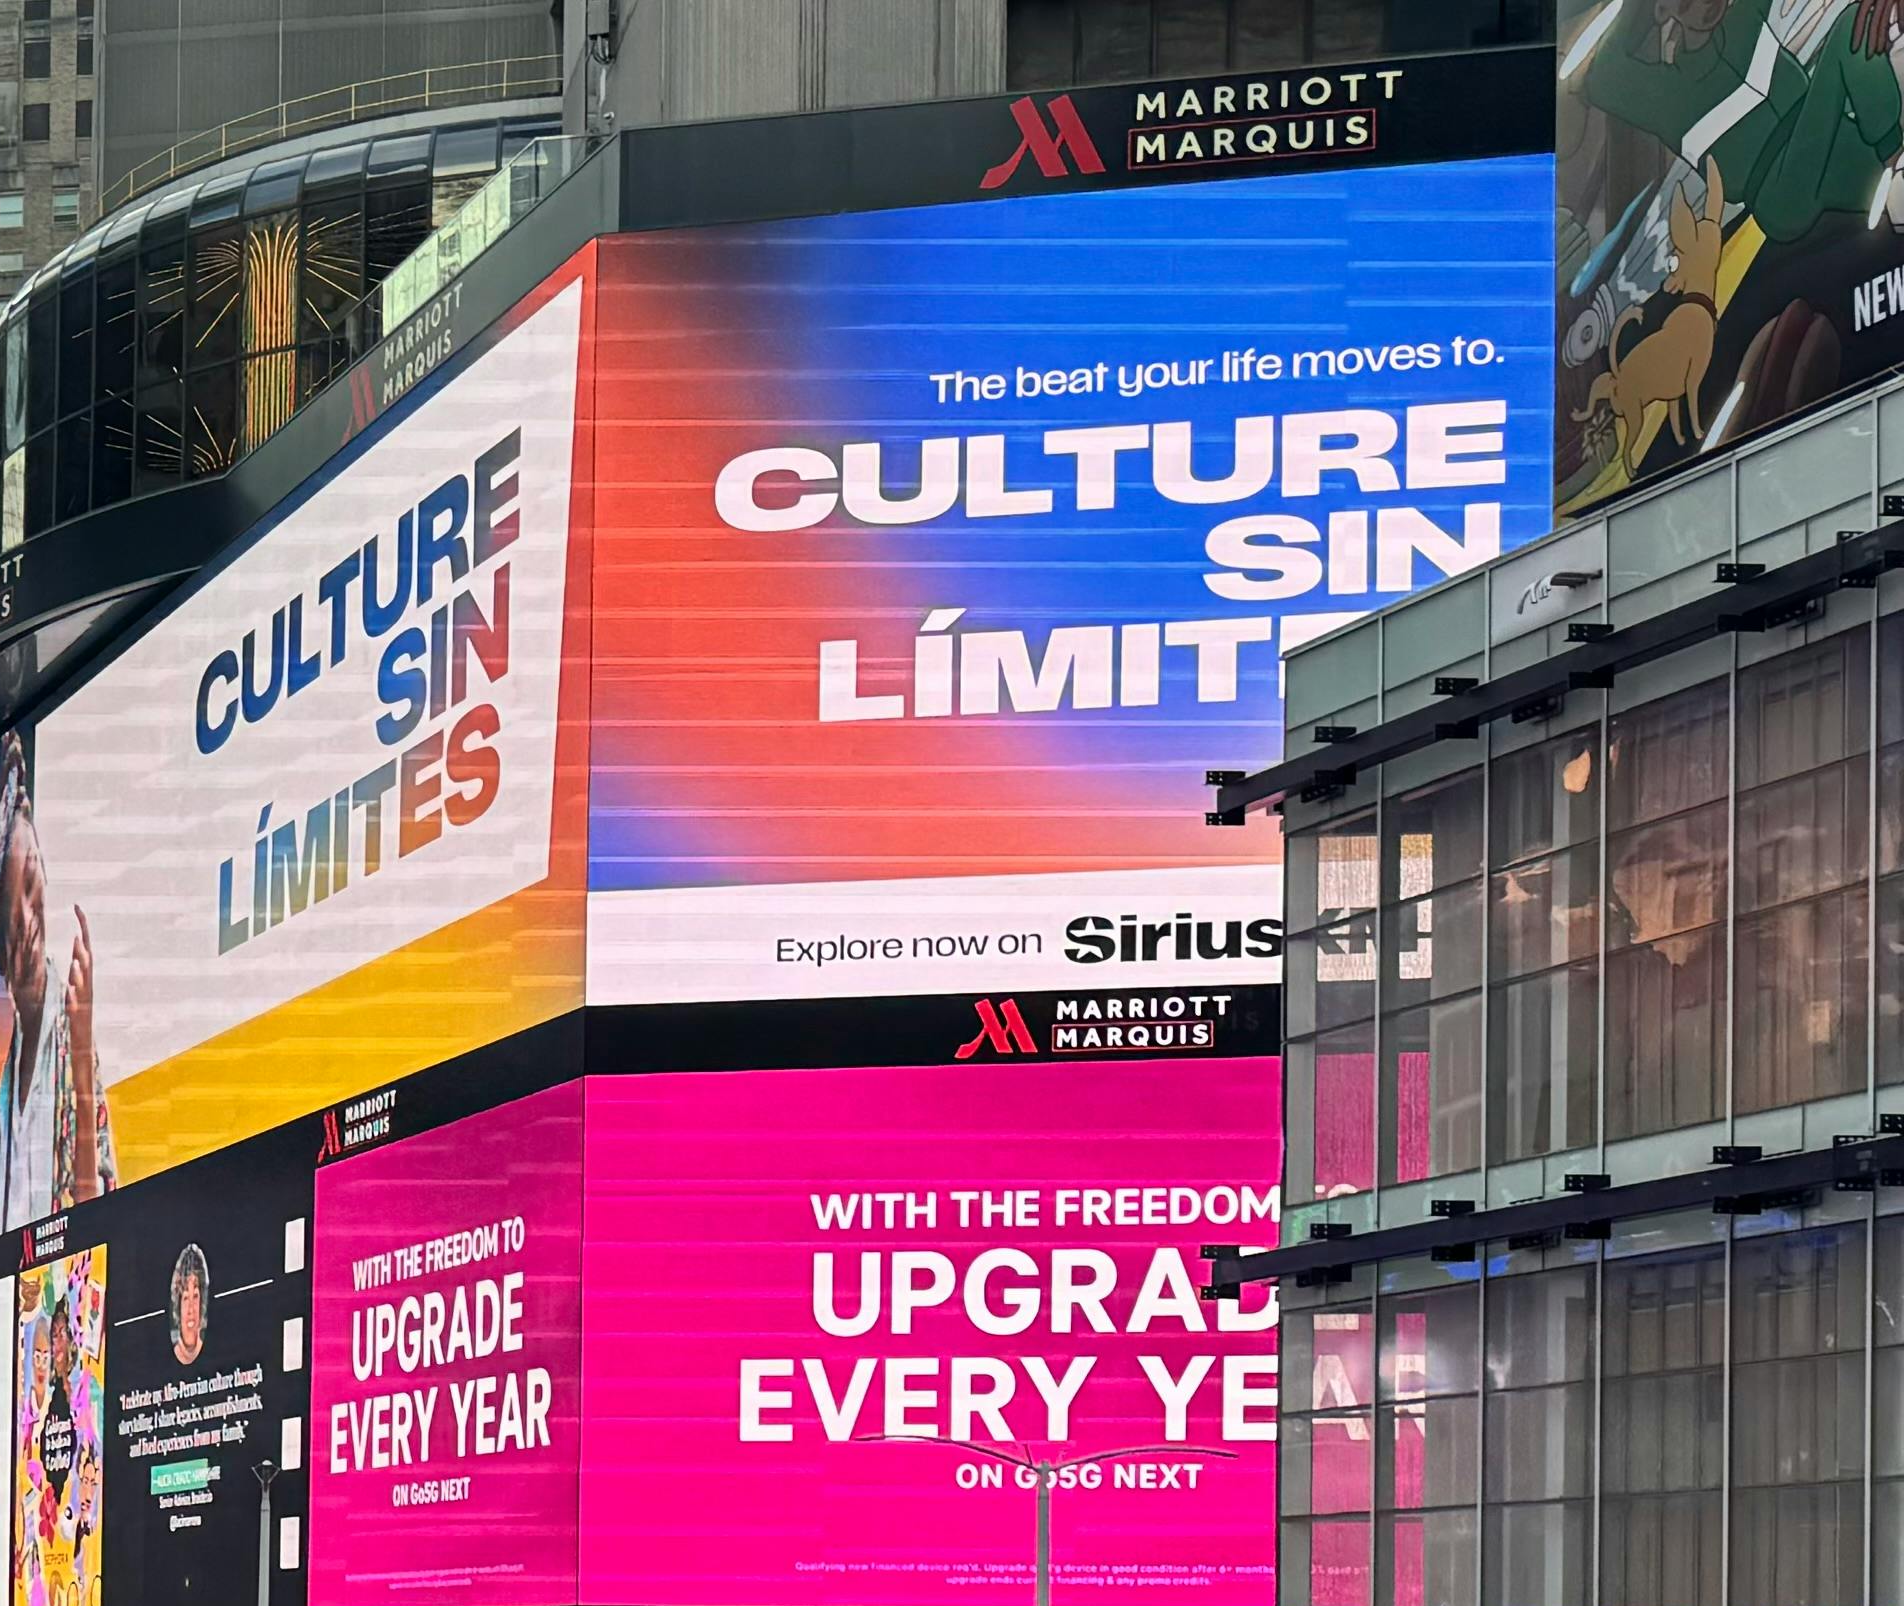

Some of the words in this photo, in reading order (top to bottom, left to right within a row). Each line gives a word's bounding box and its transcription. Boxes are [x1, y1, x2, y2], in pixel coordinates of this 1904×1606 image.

[1135, 69, 1405, 121] MARRIOTT
[1135, 115, 1371, 163] MARQUIS
[381, 326, 453, 405] MARQUIS
[383, 284, 464, 369] MARRIOTT
[930, 369, 1007, 403] The
[1015, 361, 1108, 400] beat
[1117, 353, 1214, 398] your
[1221, 348, 1282, 384] life
[1291, 340, 1443, 377] moves
[1451, 333, 1505, 367] to.
[713, 398, 1507, 533] CULTURE
[1202, 502, 1502, 600] SIN
[195, 426, 522, 755] CULTURE
[376, 561, 510, 747] SIN
[218, 703, 502, 957] LÍMITES
[774, 930, 905, 965] Explore
[913, 930, 975, 957] now
[986, 929, 1044, 954] on
[1055, 995, 1232, 1022] MARRIOTT
[1055, 1022, 1210, 1049] MARQUIS
[810, 1192, 938, 1231] WITH
[951, 1190, 1040, 1229] THE
[1055, 1185, 1281, 1226] FREEDOM
[352, 1255, 392, 1293] WITH
[394, 1249, 423, 1285] THE
[425, 1229, 499, 1277] FREEDOM
[502, 1215, 525, 1256] TO
[352, 1272, 525, 1383] UPGRADE
[330, 1386, 440, 1475] EVERY
[450, 1367, 552, 1457] YEAR
[739, 1354, 1096, 1442] EVERY
[441, 1477, 470, 1502] NEXT
[955, 1463, 1004, 1489] ON
[1114, 1463, 1203, 1489] NEXT
